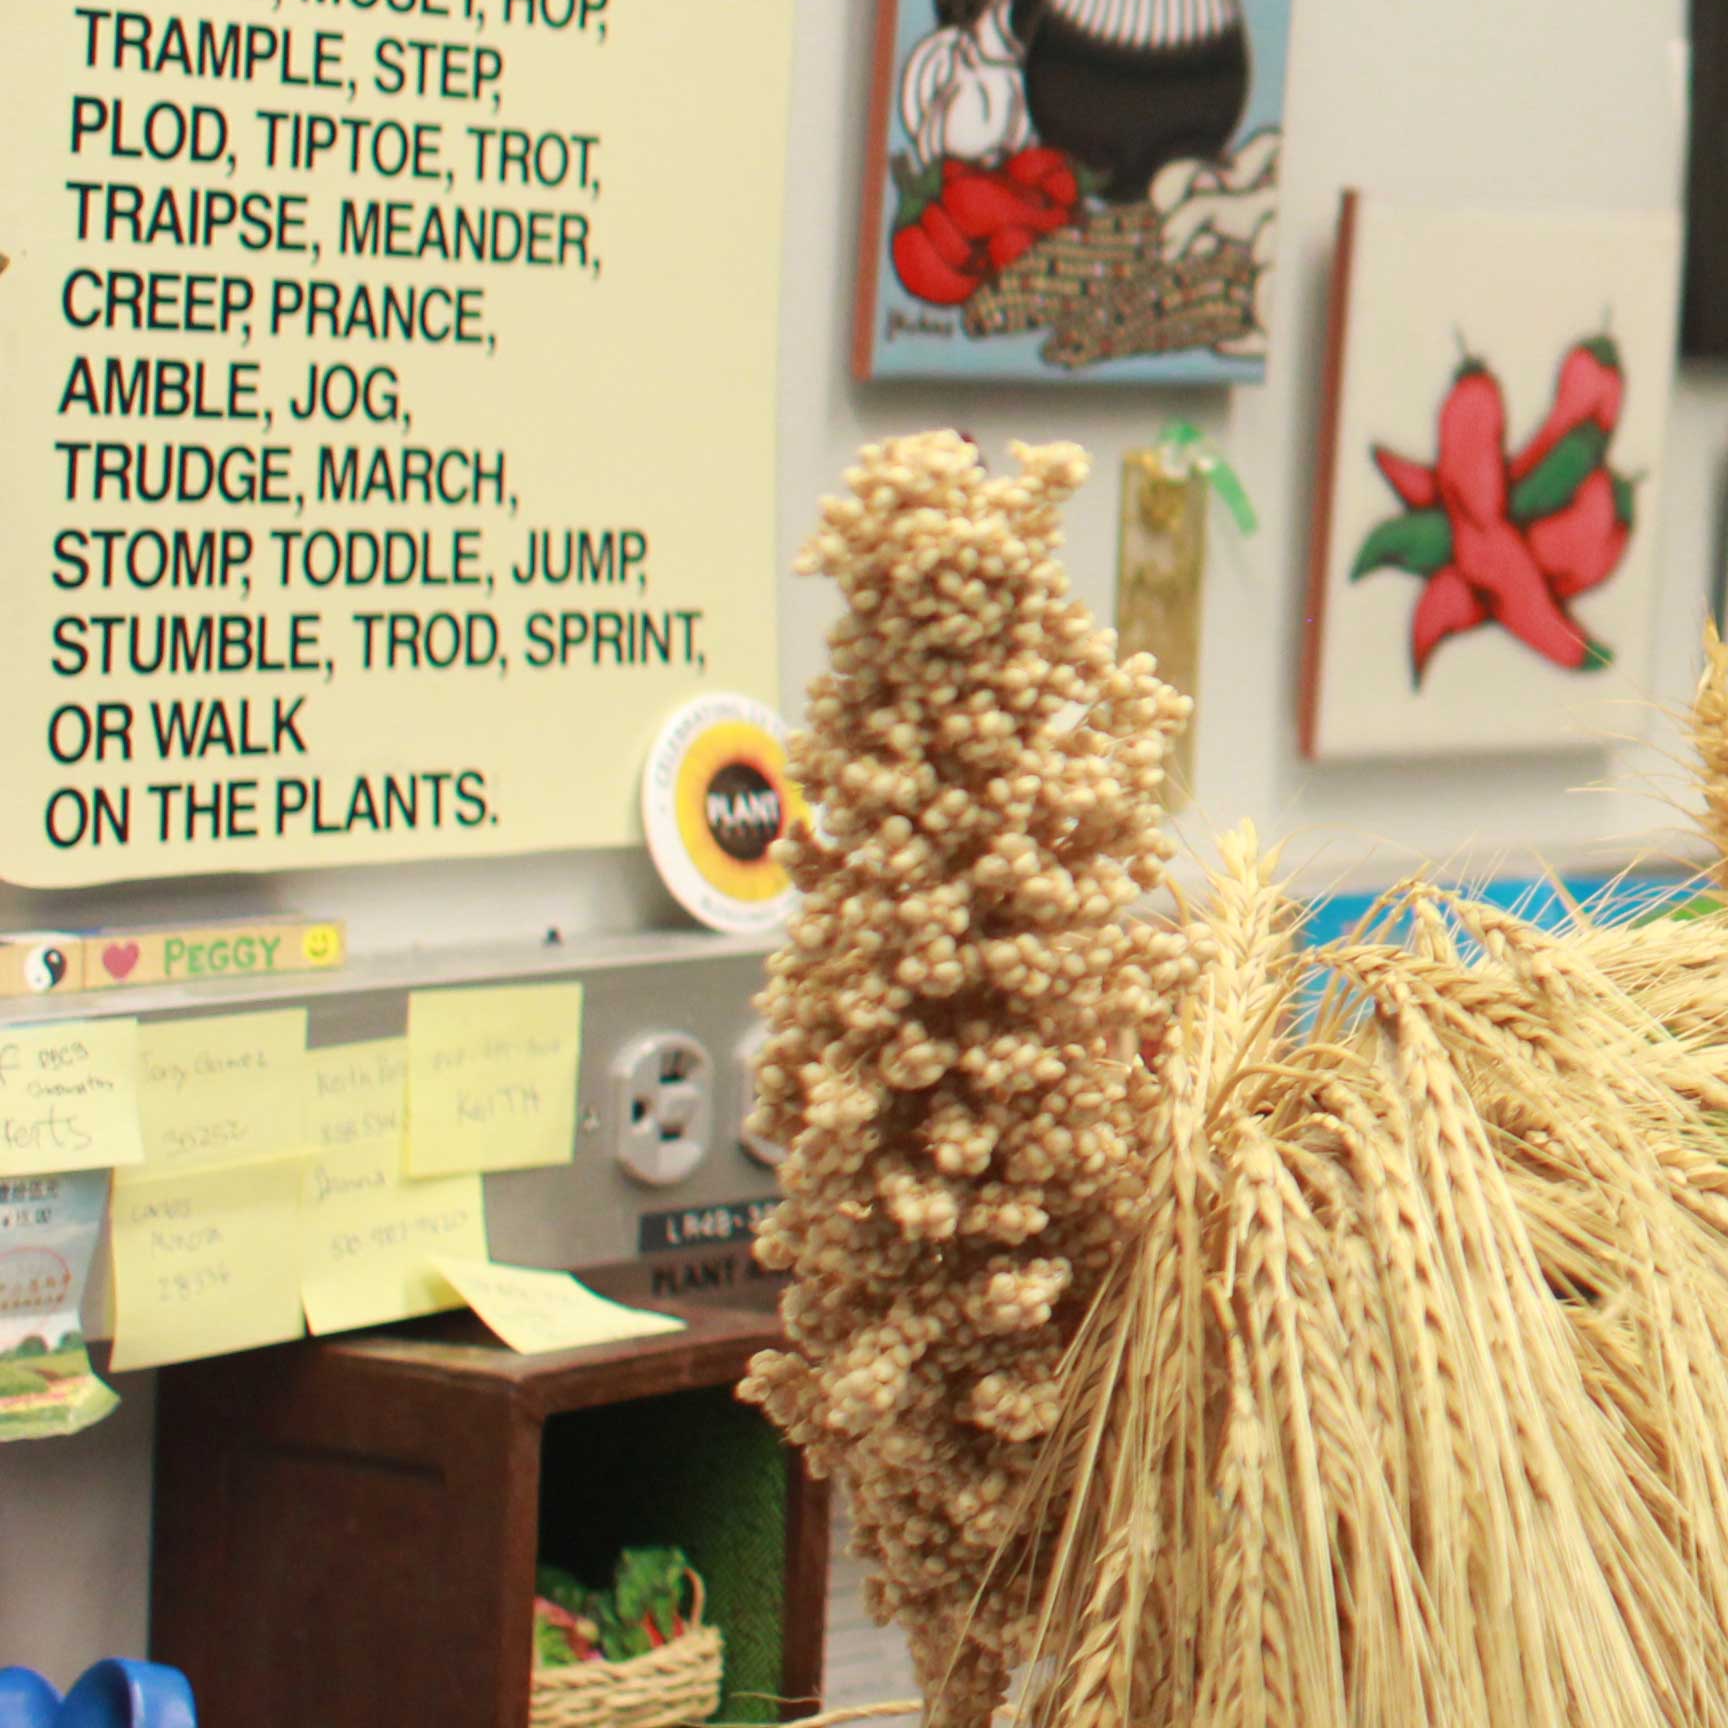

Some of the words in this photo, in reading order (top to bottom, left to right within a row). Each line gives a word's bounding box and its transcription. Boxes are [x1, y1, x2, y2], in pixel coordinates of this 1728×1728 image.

[76, 8, 356, 100] TRAMPLE,
[375, 38, 503, 107] STEP,
[72, 95, 237, 173] PLOD,
[257, 110, 454, 186] TIPTOE,
[468, 127, 601, 195] TROT,
[67, 181, 320, 259] TRAIPSE,
[340, 199, 601, 270] MEANDER,
[62, 268, 255, 345] CREEP,
[272, 279, 497, 350] PRANCE,
[58, 356, 273, 428] AMBLE,
[290, 363, 412, 429] JOG,
[55, 441, 305, 514] TRUDGE,
[318, 445, 518, 513] MARCH,
[52, 528, 253, 597] STOMP,
[271, 529, 494, 594] TODDLE,
[513, 529, 648, 592] JUMP,
[52, 613, 334, 682] STUMBLE,
[353, 612, 507, 677] TROD,
[526, 611, 706, 668] SPRINT,
[48, 701, 134, 765] OR
[150, 697, 307, 759] WALK
[45, 786, 131, 849] ON
[148, 779, 258, 842] THE
[276, 770, 500, 835] PLANTS.
[707, 790, 779, 827] PLANT
[163, 935, 282, 977] PEGGY
